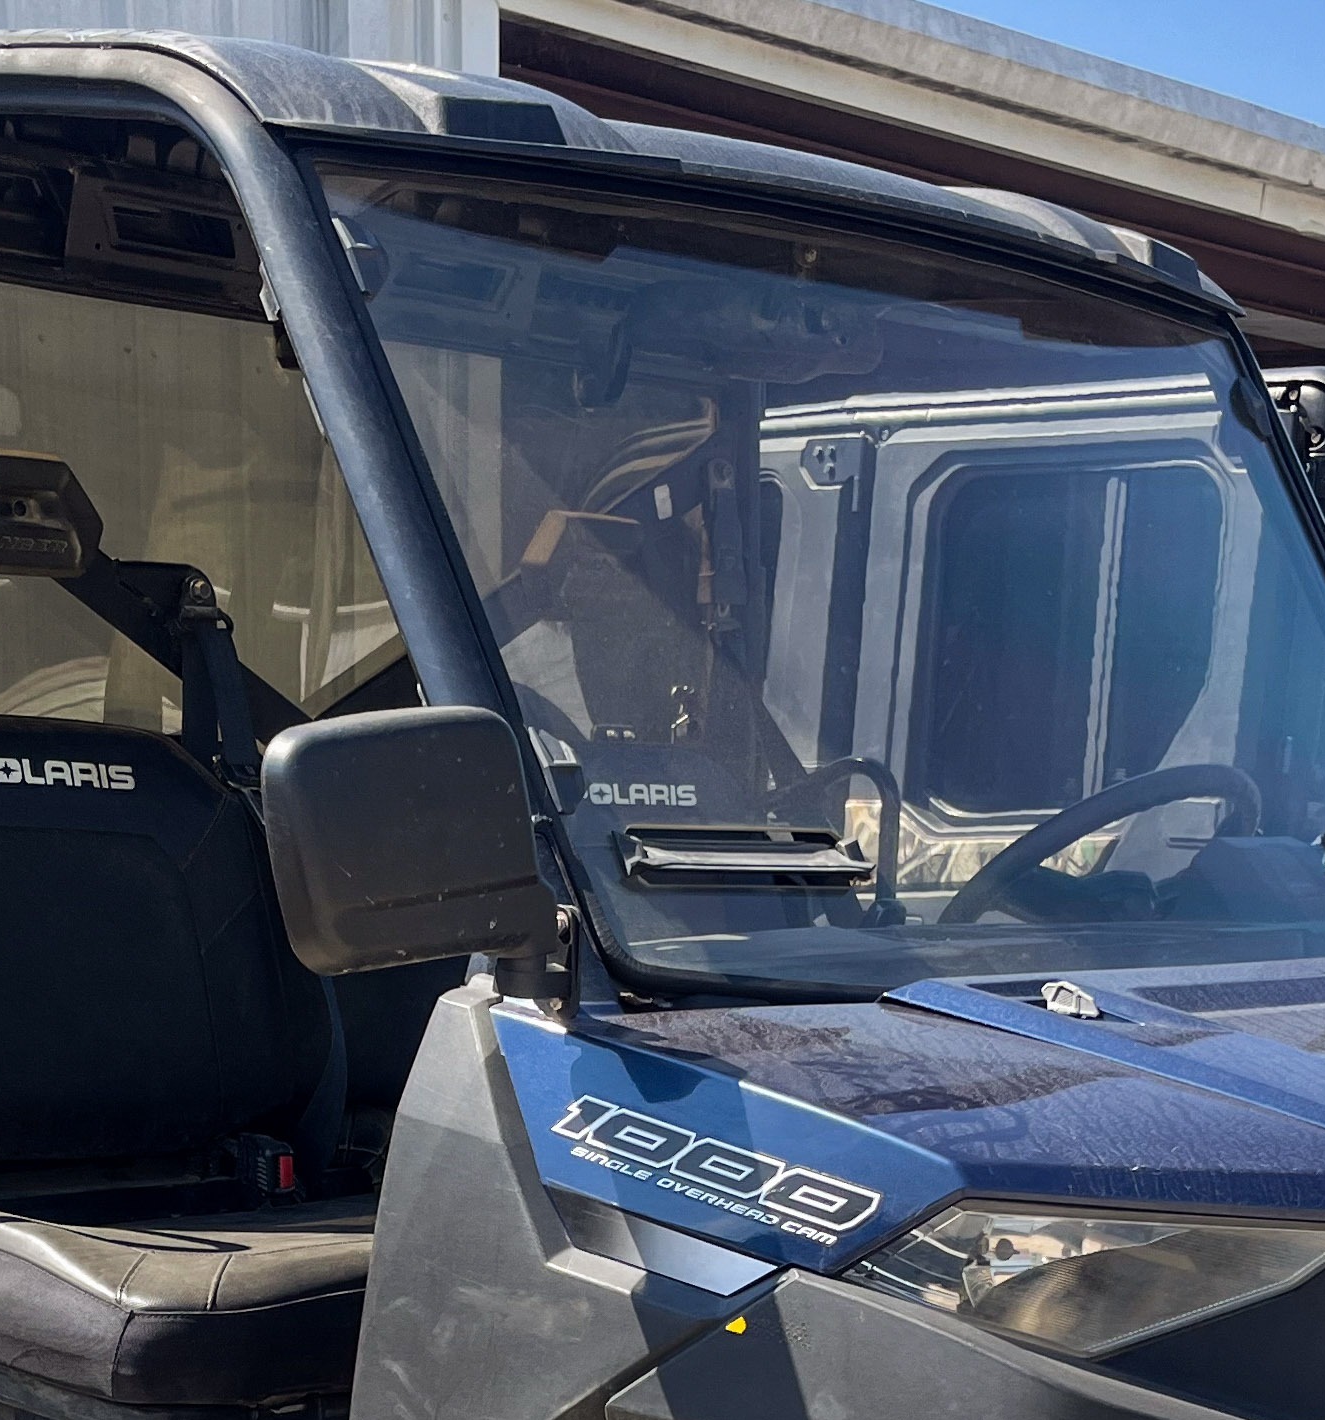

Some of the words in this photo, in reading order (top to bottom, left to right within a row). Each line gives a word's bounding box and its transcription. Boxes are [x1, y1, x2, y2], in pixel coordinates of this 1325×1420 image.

[583, 783, 697, 807] OLARIS
[550, 1094, 881, 1232] 1000
[570, 1146, 650, 1182] SINGLE
[656, 1176, 779, 1227] OVERHEAD
[778, 1213, 839, 1248] CAM
